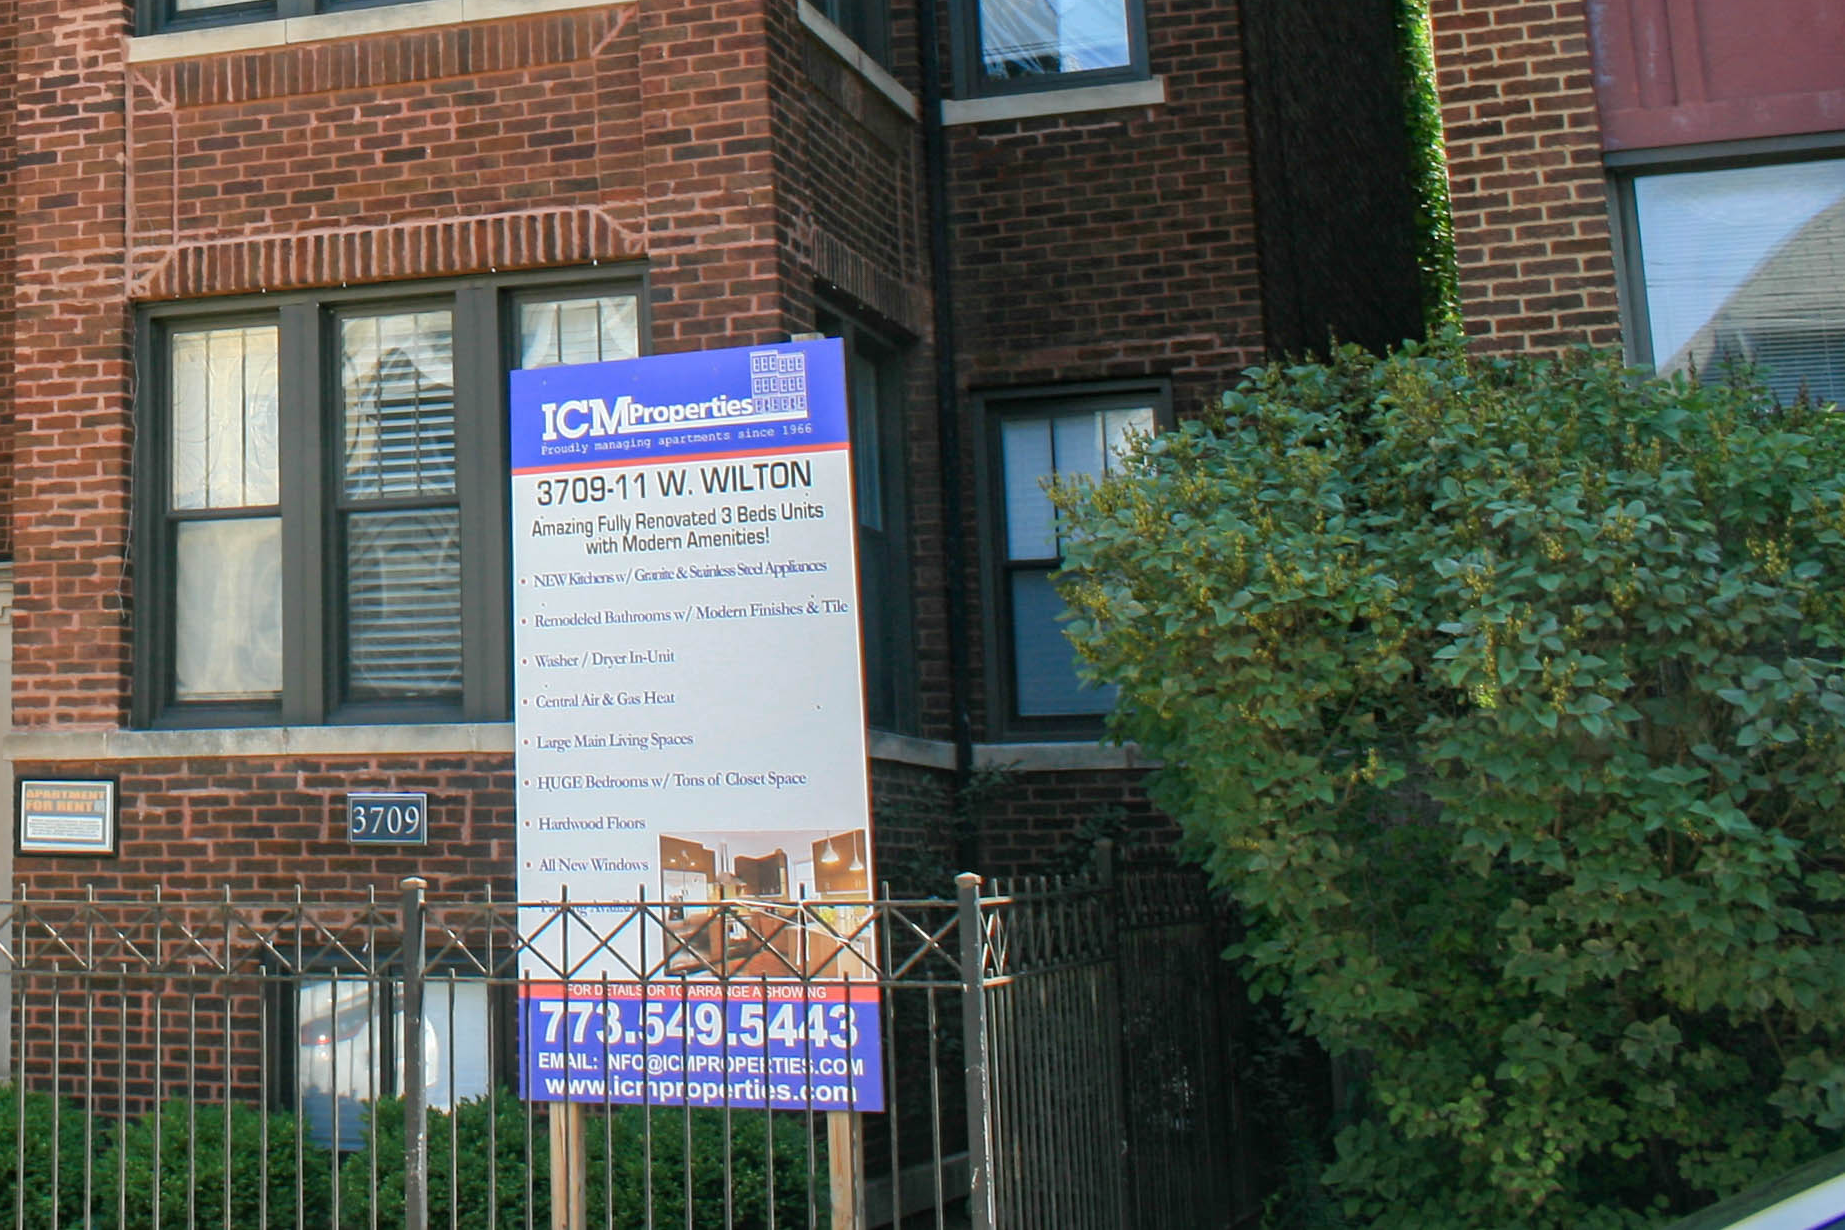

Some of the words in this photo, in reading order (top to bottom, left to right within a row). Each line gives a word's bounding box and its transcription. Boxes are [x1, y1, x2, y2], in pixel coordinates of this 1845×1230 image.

[541, 396, 632, 441] ICM
[629, 395, 753, 424] Properties
[541, 441, 588, 455] Proudly
[594, 437, 651, 451] managing
[658, 431, 731, 447] apartments
[738, 427, 775, 440] since
[783, 423, 812, 435] 1966
[537, 472, 646, 506] 3709-11
[657, 469, 693, 497] W.
[700, 460, 812, 494] WILTON
[532, 518, 593, 538] Amazing
[598, 514, 631, 535] Fully
[635, 508, 717, 530] Renovated
[721, 506, 732, 524] 3
[737, 504, 777, 523] Beds
[781, 501, 825, 520] Units
[586, 536, 618, 554] with
[623, 534, 682, 552] Modern
[687, 526, 770, 548] Amenities!
[534, 574, 566, 587] NEW
[569, 571, 615, 585] Kitchens
[635, 567, 675, 581] Granite
[676, 566, 688, 579] &
[689, 564, 735, 578] Stainless
[737, 562, 763, 576] Steel
[765, 560, 828, 578] Appliances
[535, 612, 601, 627] Remodeled
[604, 610, 671, 624] Bathrooms
[673, 606, 692, 622] w/
[696, 604, 746, 619] Modern
[749, 601, 803, 617] Finishes
[805, 600, 819, 615] &
[821, 599, 848, 613] Tile
[535, 654, 579, 667] Washer
[592, 652, 627, 668] Dryer
[630, 649, 675, 664] In-Unit
[536, 694, 579, 708] Central
[581, 693, 600, 707] Air
[602, 691, 614, 706] &
[617, 691, 642, 705] Gas
[644, 690, 675, 704] Heat
[537, 735, 571, 752] Large
[574, 734, 606, 748] Main
[609, 733, 649, 750] Living
[650, 732, 694, 750] Spaces
[538, 776, 582, 790] HUGE
[585, 775, 649, 789] Bedrooms
[651, 773, 670, 789] w/
[673, 773, 704, 787] Tons
[707, 772, 722, 786] of
[725, 772, 766, 786] Closet
[767, 771, 807, 788] Space
[25, 800, 52, 812] FOR
[57, 801, 93, 813] RENT
[26, 790, 107, 801] APARTMENT
[352, 805, 420, 835] 3709
[539, 817, 603, 830] Hardwood
[606, 816, 646, 830] Floors
[539, 858, 555, 871] All
[559, 858, 588, 871] New
[590, 858, 649, 871] Windows
[647, 984, 669, 997] OR
[670, 984, 684, 997] TO
[752, 985, 762, 998] A
[766, 985, 827, 999] SHOWNG
[539, 1000, 859, 1049] 773.549.5443
[538, 1052, 599, 1070] EMAIL:
[606, 1053, 864, 1075] NFO@ICMPROPERTIES.COM
